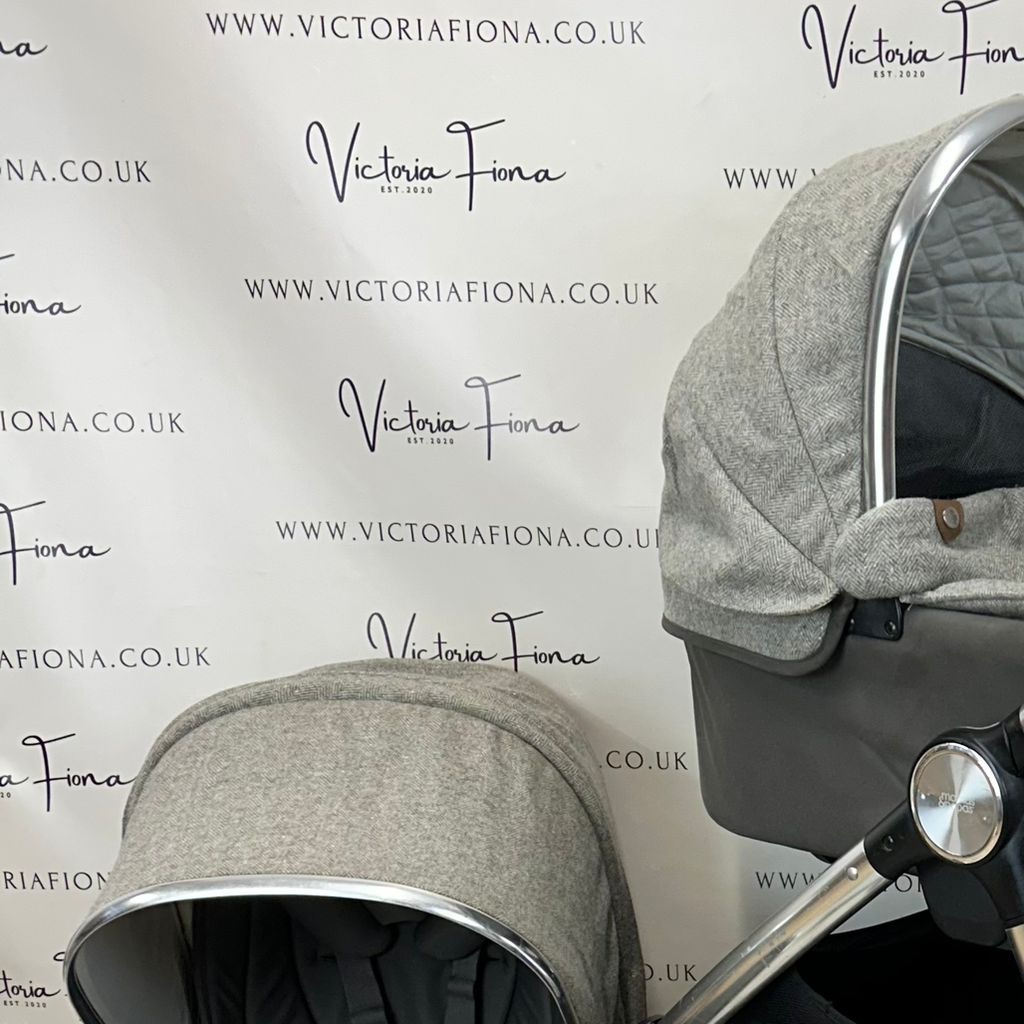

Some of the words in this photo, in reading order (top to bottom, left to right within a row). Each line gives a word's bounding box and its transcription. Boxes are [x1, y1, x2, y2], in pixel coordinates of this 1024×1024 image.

[205, 12, 646, 45] WWW.VICTORIAFIONA.CO.UK
[801, 4, 944, 89] Victoria
[873, 70, 925, 78] EST.2020
[0, 159, 151, 183] NA.CO.UK
[306, 120, 452, 204] Victoria
[446, 119, 567, 212] Fiona
[380, 185, 433, 195] EST.2020
[244, 279, 659, 305] WWW.VICTORIAFIONA.CO.UK
[338, 377, 470, 453] Victoria
[464, 374, 580, 461] Fiona
[406, 436, 455, 445] EST.2020
[0, 500, 112, 586] Fiona
[276, 521, 660, 549] WWW.VICTORIAFIONA.CO.U
[367, 612, 497, 662] Victoria
[491, 611, 600, 673] Fiona
[22, 733, 138, 812] Fiona
[0, 970, 61, 999] toria
